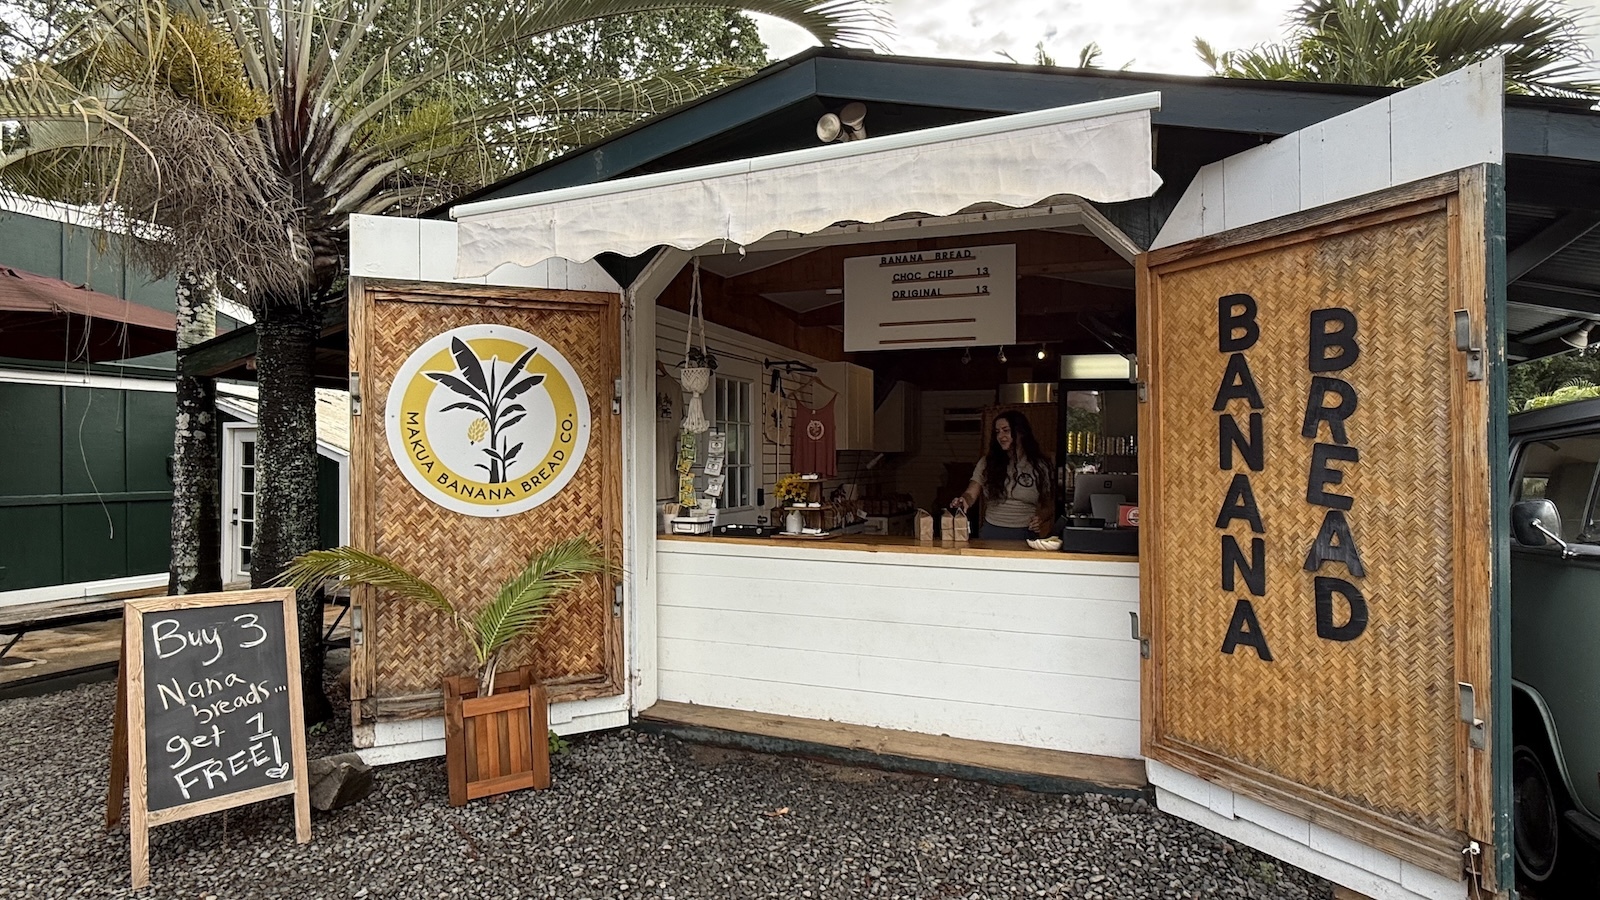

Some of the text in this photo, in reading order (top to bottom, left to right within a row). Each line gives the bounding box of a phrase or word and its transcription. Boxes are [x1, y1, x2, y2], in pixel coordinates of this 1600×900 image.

[881, 250, 972, 265] BANANA BREAD
[893, 267, 989, 282] CHOC CHIP 13
[892, 285, 988, 299] ORIGINAL 13
[406, 411, 573, 500] MAKUA BANANA BREAD CO.
[1212, 293, 1274, 662] BANANA
[1301, 307, 1369, 642] BREAD
[152, 613, 267, 666] Buy 3
[157, 672, 246, 710] Nana
[165, 712, 270, 770] get 1
[174, 736, 282, 800] FREE!
